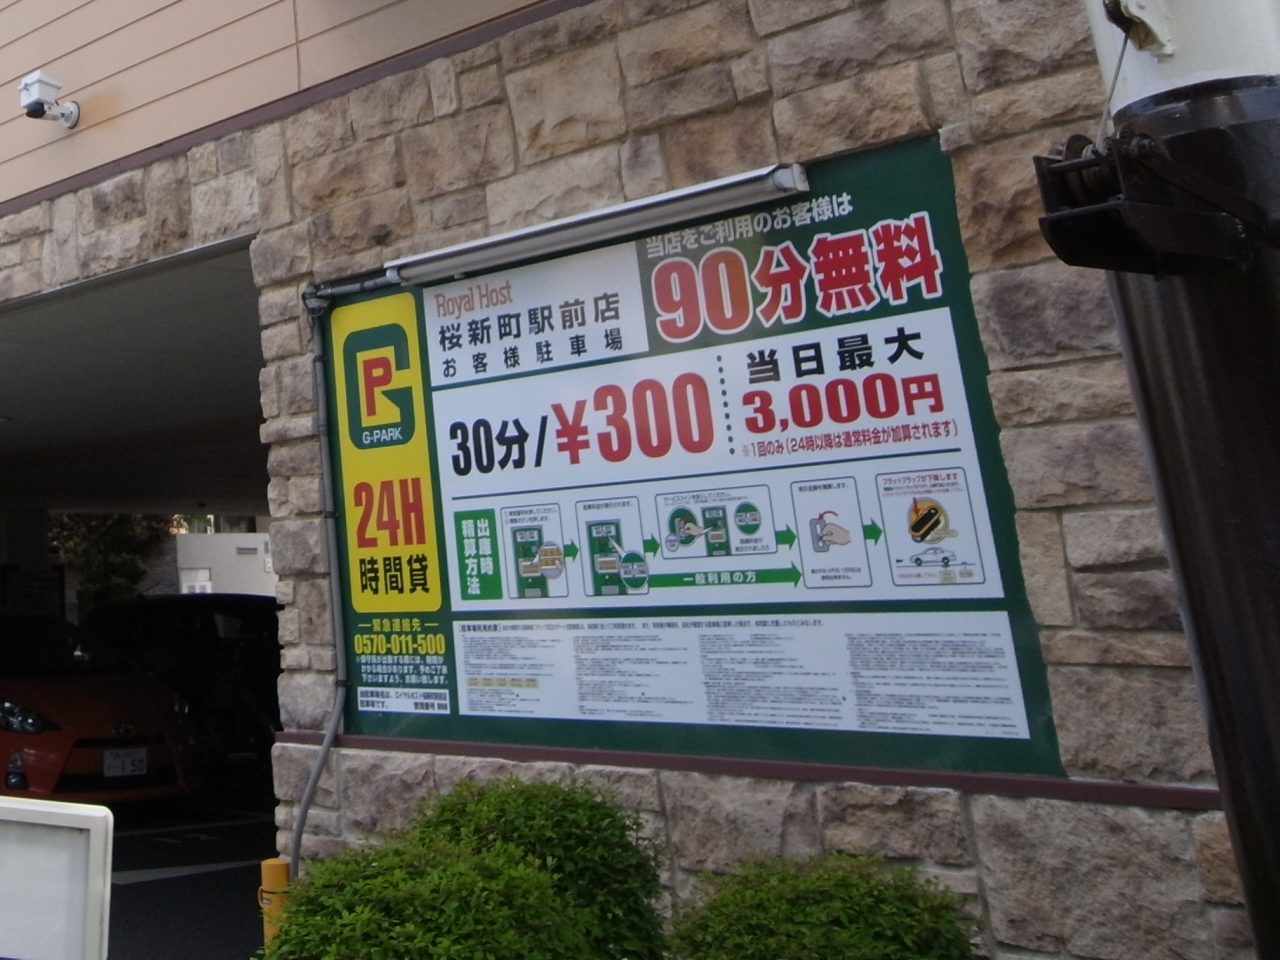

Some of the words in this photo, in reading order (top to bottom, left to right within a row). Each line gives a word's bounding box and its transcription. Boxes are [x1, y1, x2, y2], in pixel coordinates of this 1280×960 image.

[646, 192, 853, 259] 当店をご利用のお客様は
[434, 287, 474, 319] Royal
[477, 280, 513, 309] Host
[652, 211, 942, 343] 90分無料
[438, 292, 621, 352] 桜新町駅前店
[442, 328, 623, 378] お客様駐車場
[747, 327, 924, 384] 当日最大
[742, 373, 944, 434] 3,000円
[362, 427, 402, 444] G-PARK
[353, 477, 426, 548] 24H
[359, 554, 430, 595] 時間貸
[683, 571, 756, 585] 一般利用の方
[354, 634, 446, 654] 0570-011-500
